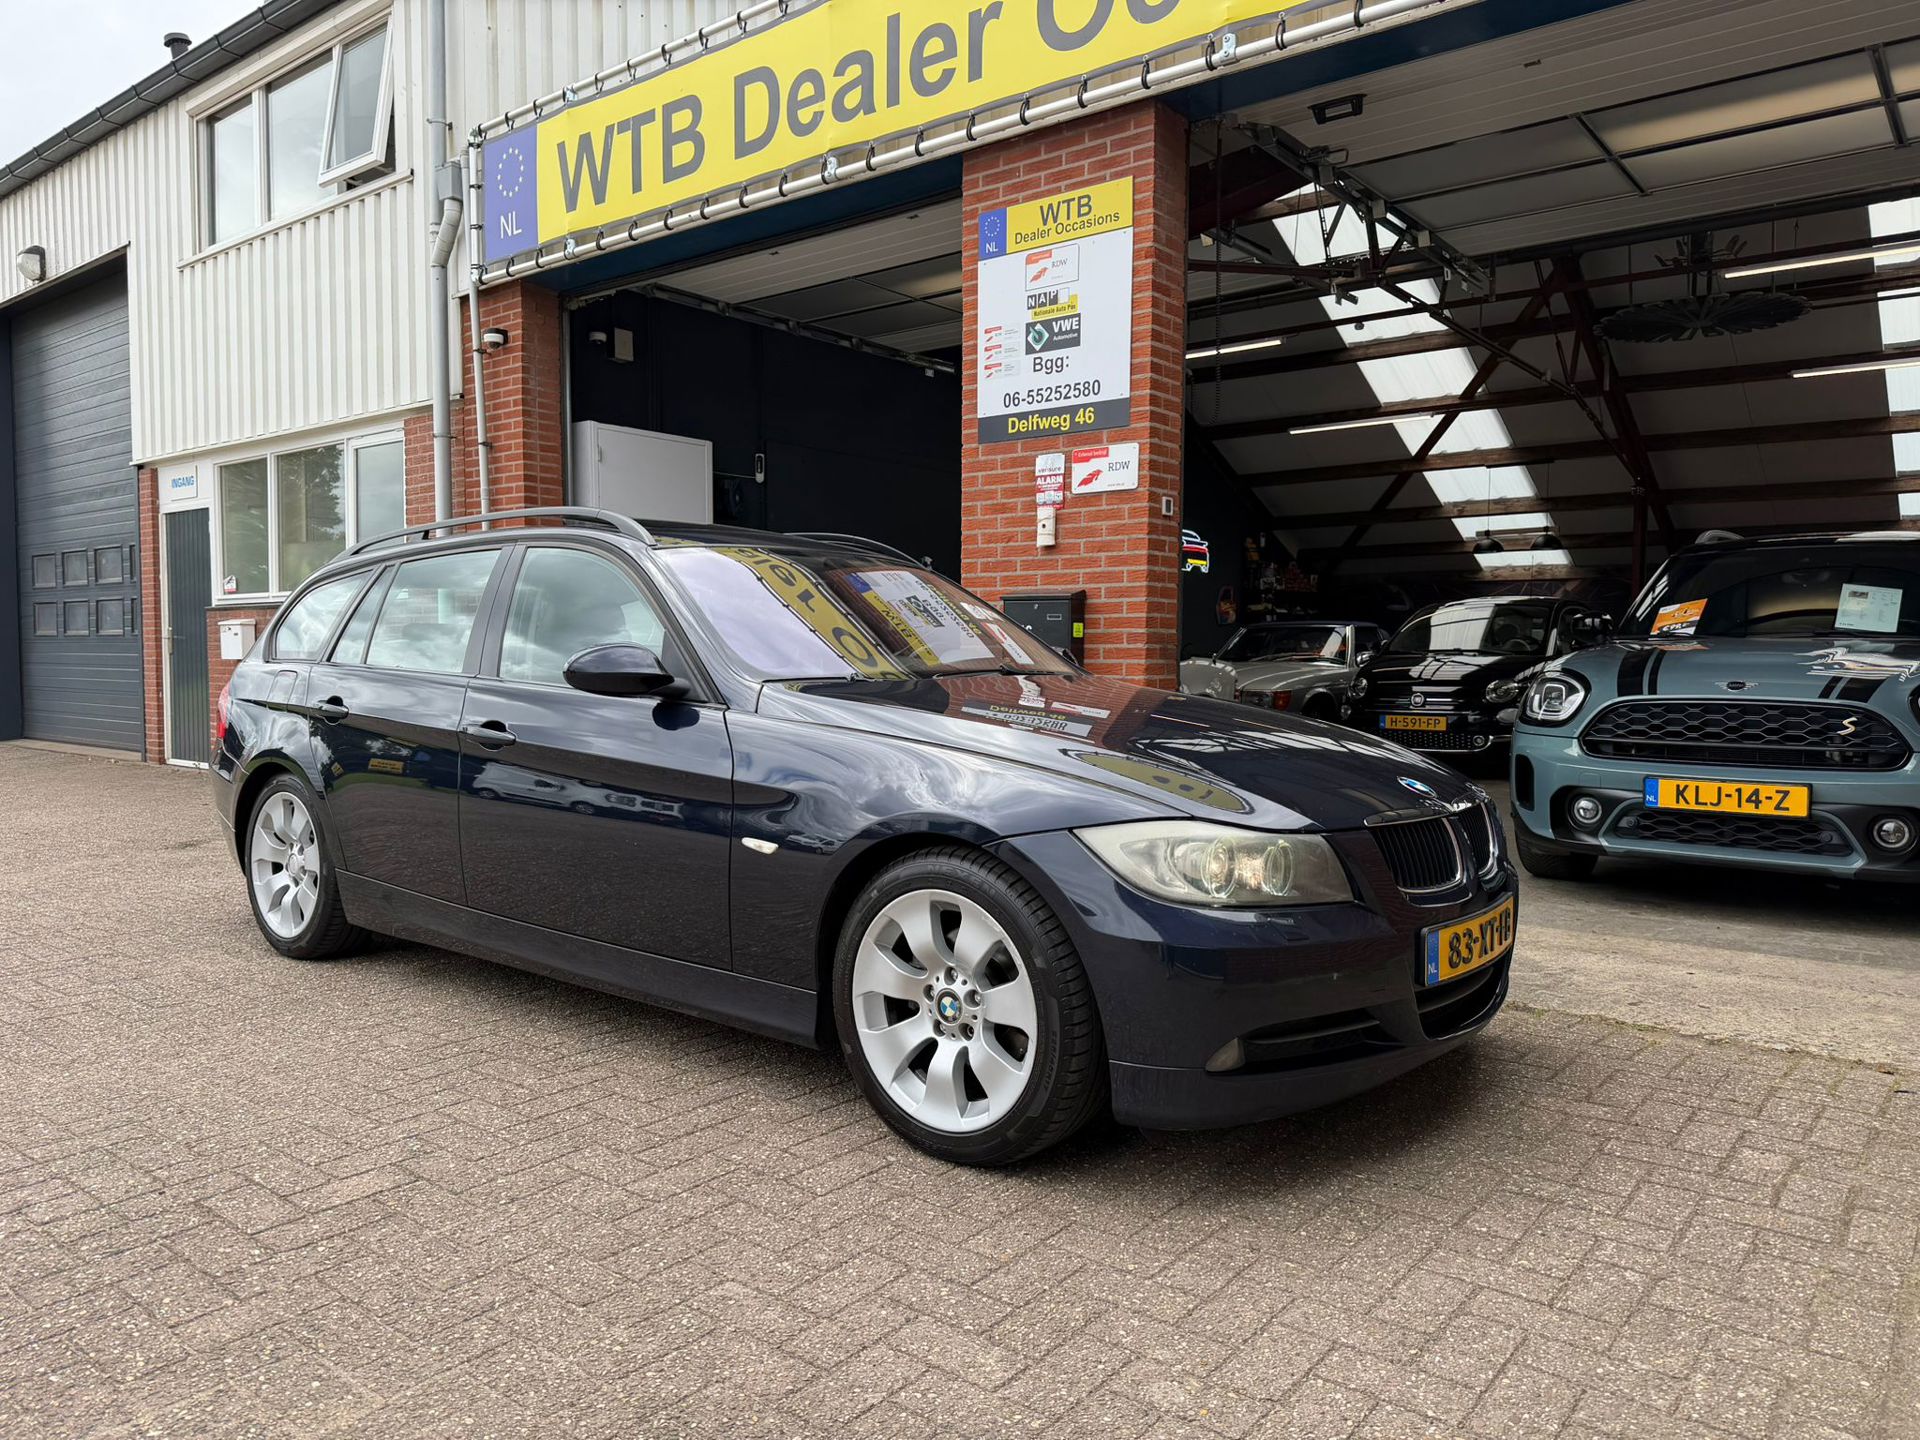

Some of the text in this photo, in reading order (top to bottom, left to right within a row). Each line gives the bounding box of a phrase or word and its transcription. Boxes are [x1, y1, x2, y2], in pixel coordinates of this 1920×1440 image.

[557, 94, 705, 214] WTB
[733, 1, 1003, 160] Dealer
[1039, 194, 1093, 227] WTB
[500, 211, 522, 239] NL
[1014, 210, 1120, 245] Dealer Occasions
[985, 241, 998, 253] NL
[1052, 317, 1079, 333] VWE
[1032, 355, 1070, 375] Bgg:
[1003, 379, 1101, 408] 06-55252580
[1007, 407, 1095, 434] Delfweg 46
[1108, 460, 1131, 472] RDW
[171, 475, 195, 489] INGANG
[1036, 475, 1063, 486] ALARM
[1390, 717, 1441, 728] H-591-FP
[1836, 717, 1857, 736] S
[1645, 794, 1657, 803] NL
[1675, 784, 1791, 812] KLJ-14-Z
[1428, 962, 1438, 974] NL
